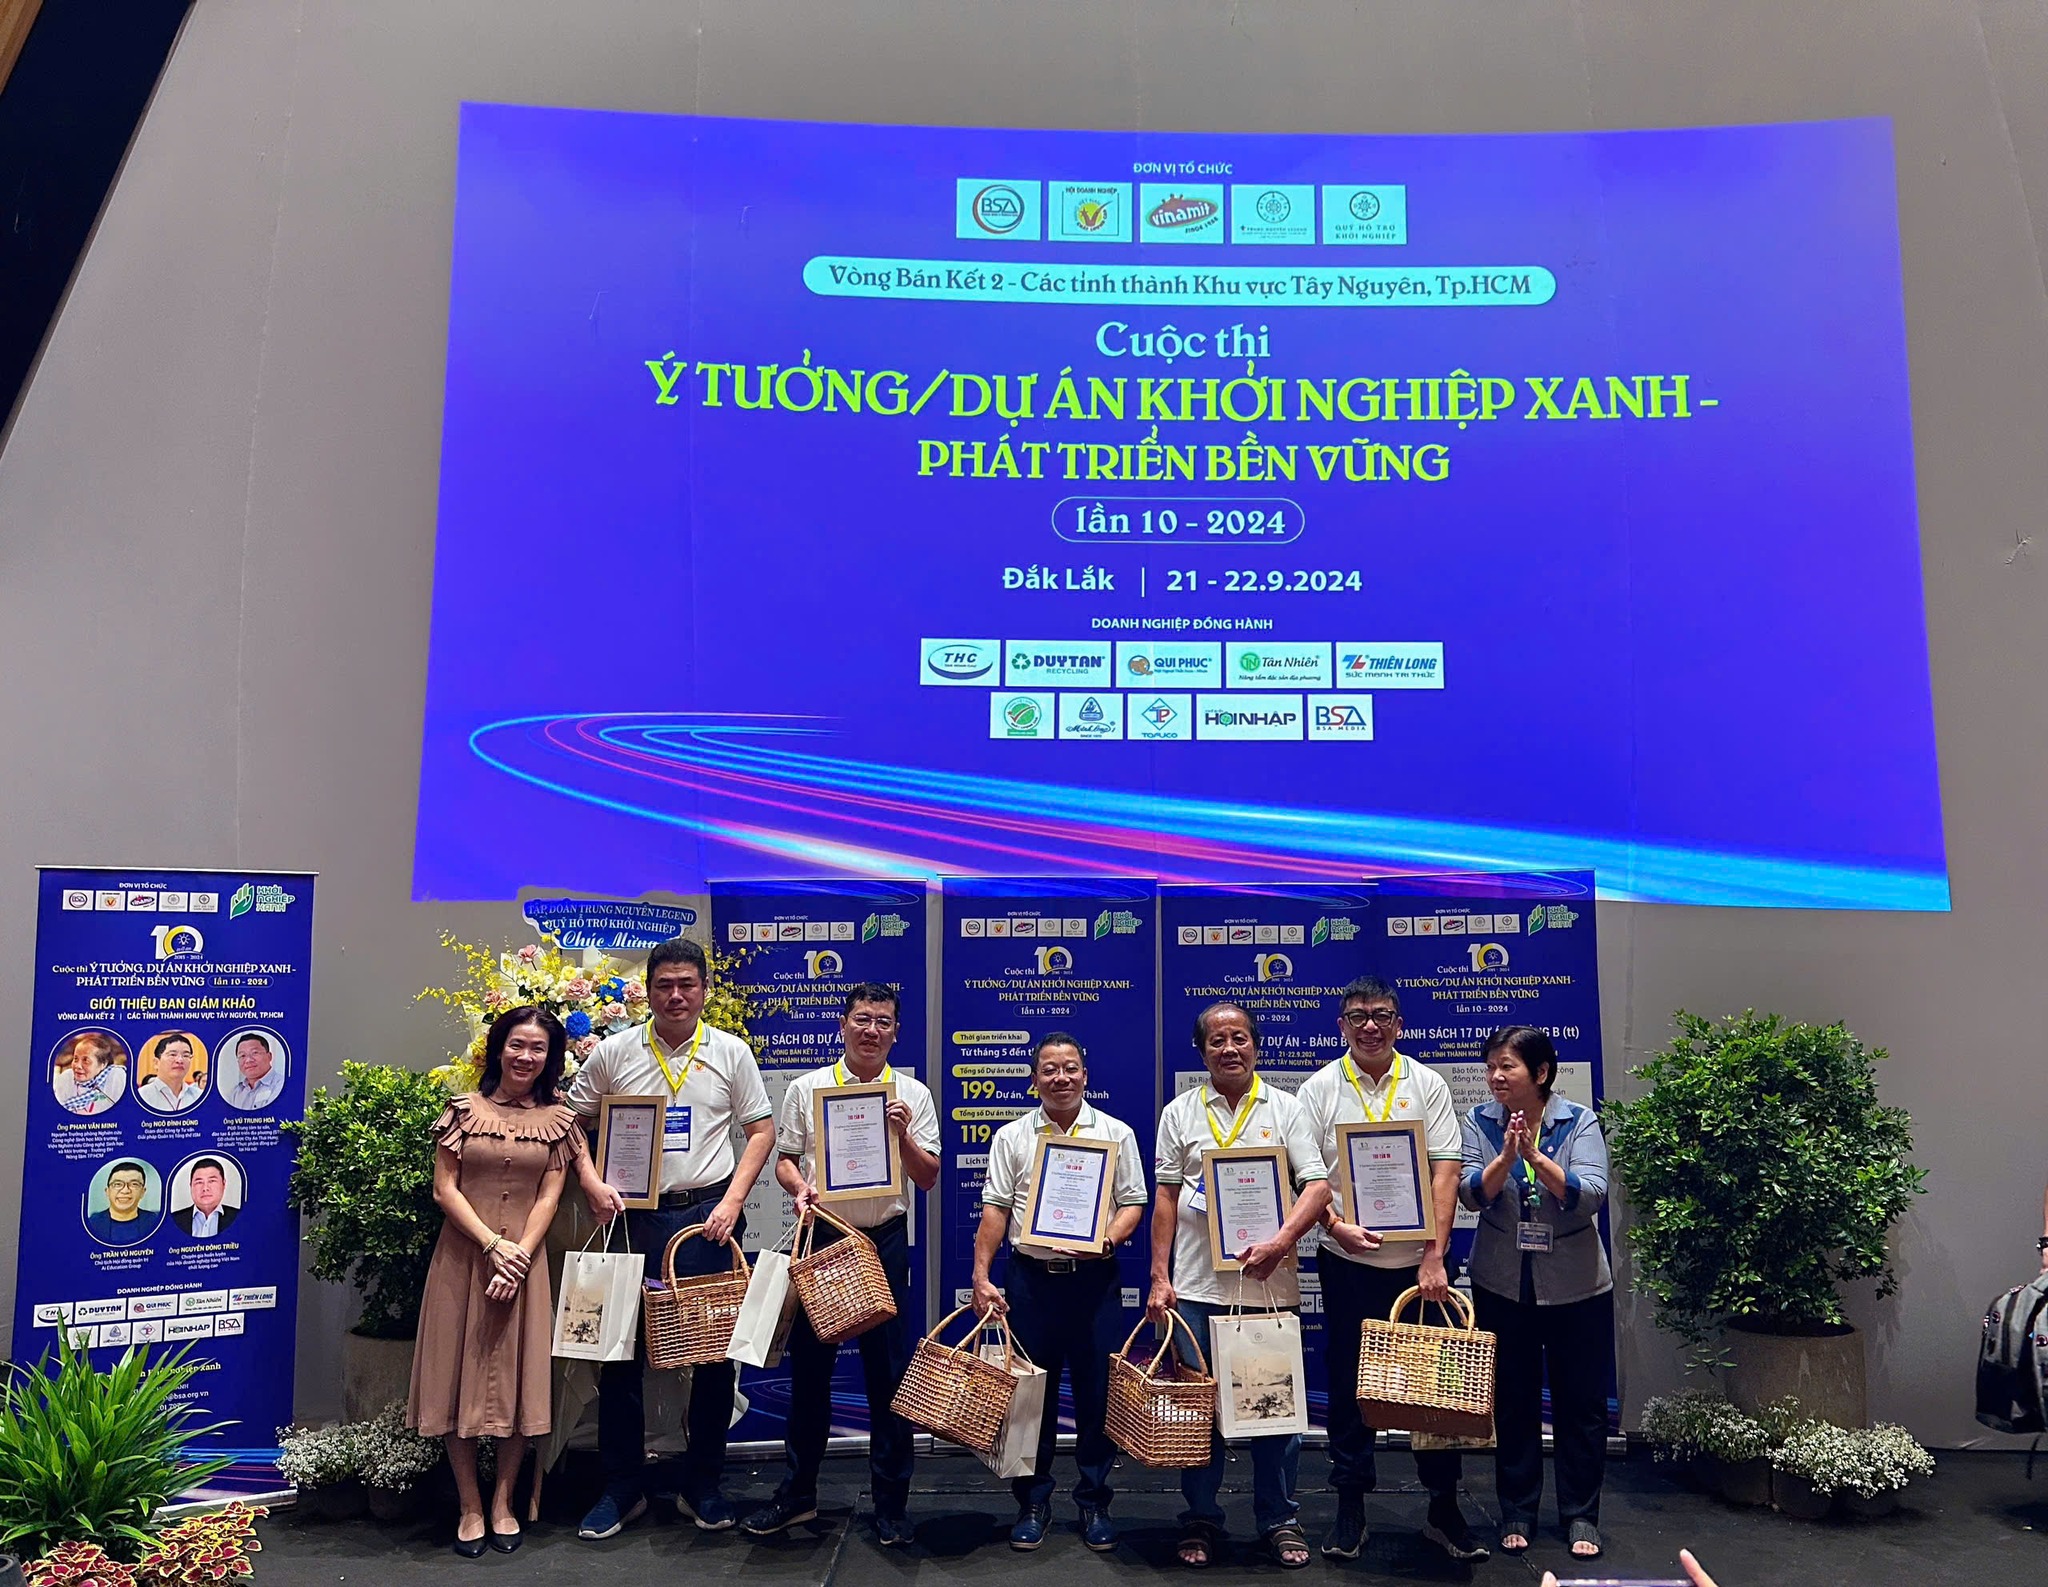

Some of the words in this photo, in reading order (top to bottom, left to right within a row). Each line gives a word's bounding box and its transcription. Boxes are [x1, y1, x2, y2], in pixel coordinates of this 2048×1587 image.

[1133, 163, 1162, 174] ĐƠN
[1164, 164, 1176, 176] VỊ
[1178, 160, 1195, 174] TỔ
[1198, 162, 1233, 175] CHỨC
[1152, 200, 1210, 227] vinamit
[829, 264, 891, 291] Vòng
[896, 267, 940, 289] Bán
[946, 267, 985, 290] Kết
[991, 274, 1004, 290] 2
[1020, 272, 1066, 292] Các
[1071, 270, 1115, 293] tỉnh
[1122, 275, 1188, 294] thành
[1193, 275, 1241, 294] Khu
[1246, 278, 1287, 299] vực
[1290, 276, 1333, 299] Tây
[1337, 275, 1431, 300] Nguyên,
[1436, 275, 1532, 299] Tp.HCM
[1096, 321, 1207, 364] Cuộc
[1214, 323, 1271, 357] thi
[645, 350, 687, 405] Ý
[1043, 366, 1128, 421] ÁN
[1137, 359, 1286, 422] KHỞI
[1296, 368, 1515, 430] NGHIỆP
[1524, 375, 1692, 420] XANH
[918, 434, 1051, 479] PHÁT
[1057, 425, 1197, 481] TRIỂN
[1205, 431, 1298, 482] BỀN
[1306, 437, 1450, 482] VỮNG
[1075, 502, 1131, 534] lần
[1141, 510, 1178, 534] 10
[1206, 510, 1286, 535] 2024
[1002, 564, 1059, 591] Đắk
[1065, 564, 1115, 591] Lắk
[1166, 570, 1197, 592] 21
[1223, 570, 1363, 592] 22.9.2024
[1091, 618, 1140, 629] DOANH
[1142, 617, 1190, 632] NGHIỆP
[1193, 616, 1232, 629] ĐỒNG
[1235, 617, 1273, 629] HÀNH
[944, 652, 978, 663] THC
[1033, 655, 1102, 668] DUYTAN
[1154, 657, 1177, 668] QUI
[1179, 657, 1208, 668] PHUC
[1262, 657, 1283, 668] Tân
[1284, 657, 1319, 668] Nhiên
[1369, 655, 1403, 670] THIÊN
[1405, 657, 1437, 670] LONG
[1315, 705, 1367, 727] BSA
[578, 904, 613, 915] TRUNG
[614, 903, 655, 917] NGUYÊN
[655, 908, 694, 923] LEGEND
[545, 917, 567, 931] QUỸ
[569, 914, 585, 928] HỖ
[586, 918, 608, 930] TRỢ
[609, 916, 636, 930] KHỞI
[637, 921, 676, 935] NGHIỆP
[562, 931, 605, 948] Chúc
[52, 965, 76, 974] Cuộc
[76, 964, 88, 973] thi
[89, 961, 98, 973] Ý
[184, 960, 214, 973] KHỞI
[215, 962, 258, 975] NGHIỆP
[259, 964, 291, 974] XANH
[1004, 967, 1024, 976] Cuộc
[1024, 967, 1035, 976] thi
[76, 974, 108, 987] PHÁT
[172, 975, 205, 986] VỮNG
[90, 995, 116, 1010] GIỚI
[119, 996, 156, 1011] THIỆU
[159, 998, 185, 1010] BAN
[188, 995, 219, 1009] GIÁM
[222, 994, 256, 1009] KHẢO
[58, 1012, 78, 1021] VÒNG
[79, 1012, 94, 1020] BÁN
[95, 1011, 108, 1020] KẾT
[126, 1012, 141, 1020] CÁC
[160, 1011, 184, 1020] THÀNH
[201, 1011, 215, 1020] VỰC
[216, 1011, 228, 1019] TÂY
[260, 1011, 284, 1019] TP.HCM
[1036, 1007, 1045, 1015] 10
[1051, 1007, 1070, 1015] 2024
[772, 1032, 800, 1045] SÁCH
[802, 1034, 815, 1044] 08
[817, 1034, 833, 1047] DỰ
[975, 1034, 990, 1042] gian
[1428, 1026, 1457, 1039] SÁCH
[1460, 1027, 1472, 1039] 17
[1475, 1026, 1491, 1040] DỰ
[1552, 1026, 1560, 1038] B
[1562, 1025, 1580, 1040] (tt)
[1268, 1036, 1284, 1049] DỰ
[1285, 1034, 1300, 1047] ÁN
[1309, 1034, 1338, 1047] BẢNG
[961, 1048, 972, 1056] Từ
[973, 1047, 1000, 1058] tháng
[1002, 1048, 1007, 1056] 5
[1009, 1047, 1026, 1056] đến
[961, 1080, 996, 1100] 199
[996, 1090, 1009, 1101] Dự
[961, 1124, 991, 1143] 119
[965, 1157, 981, 1167] Lịch
